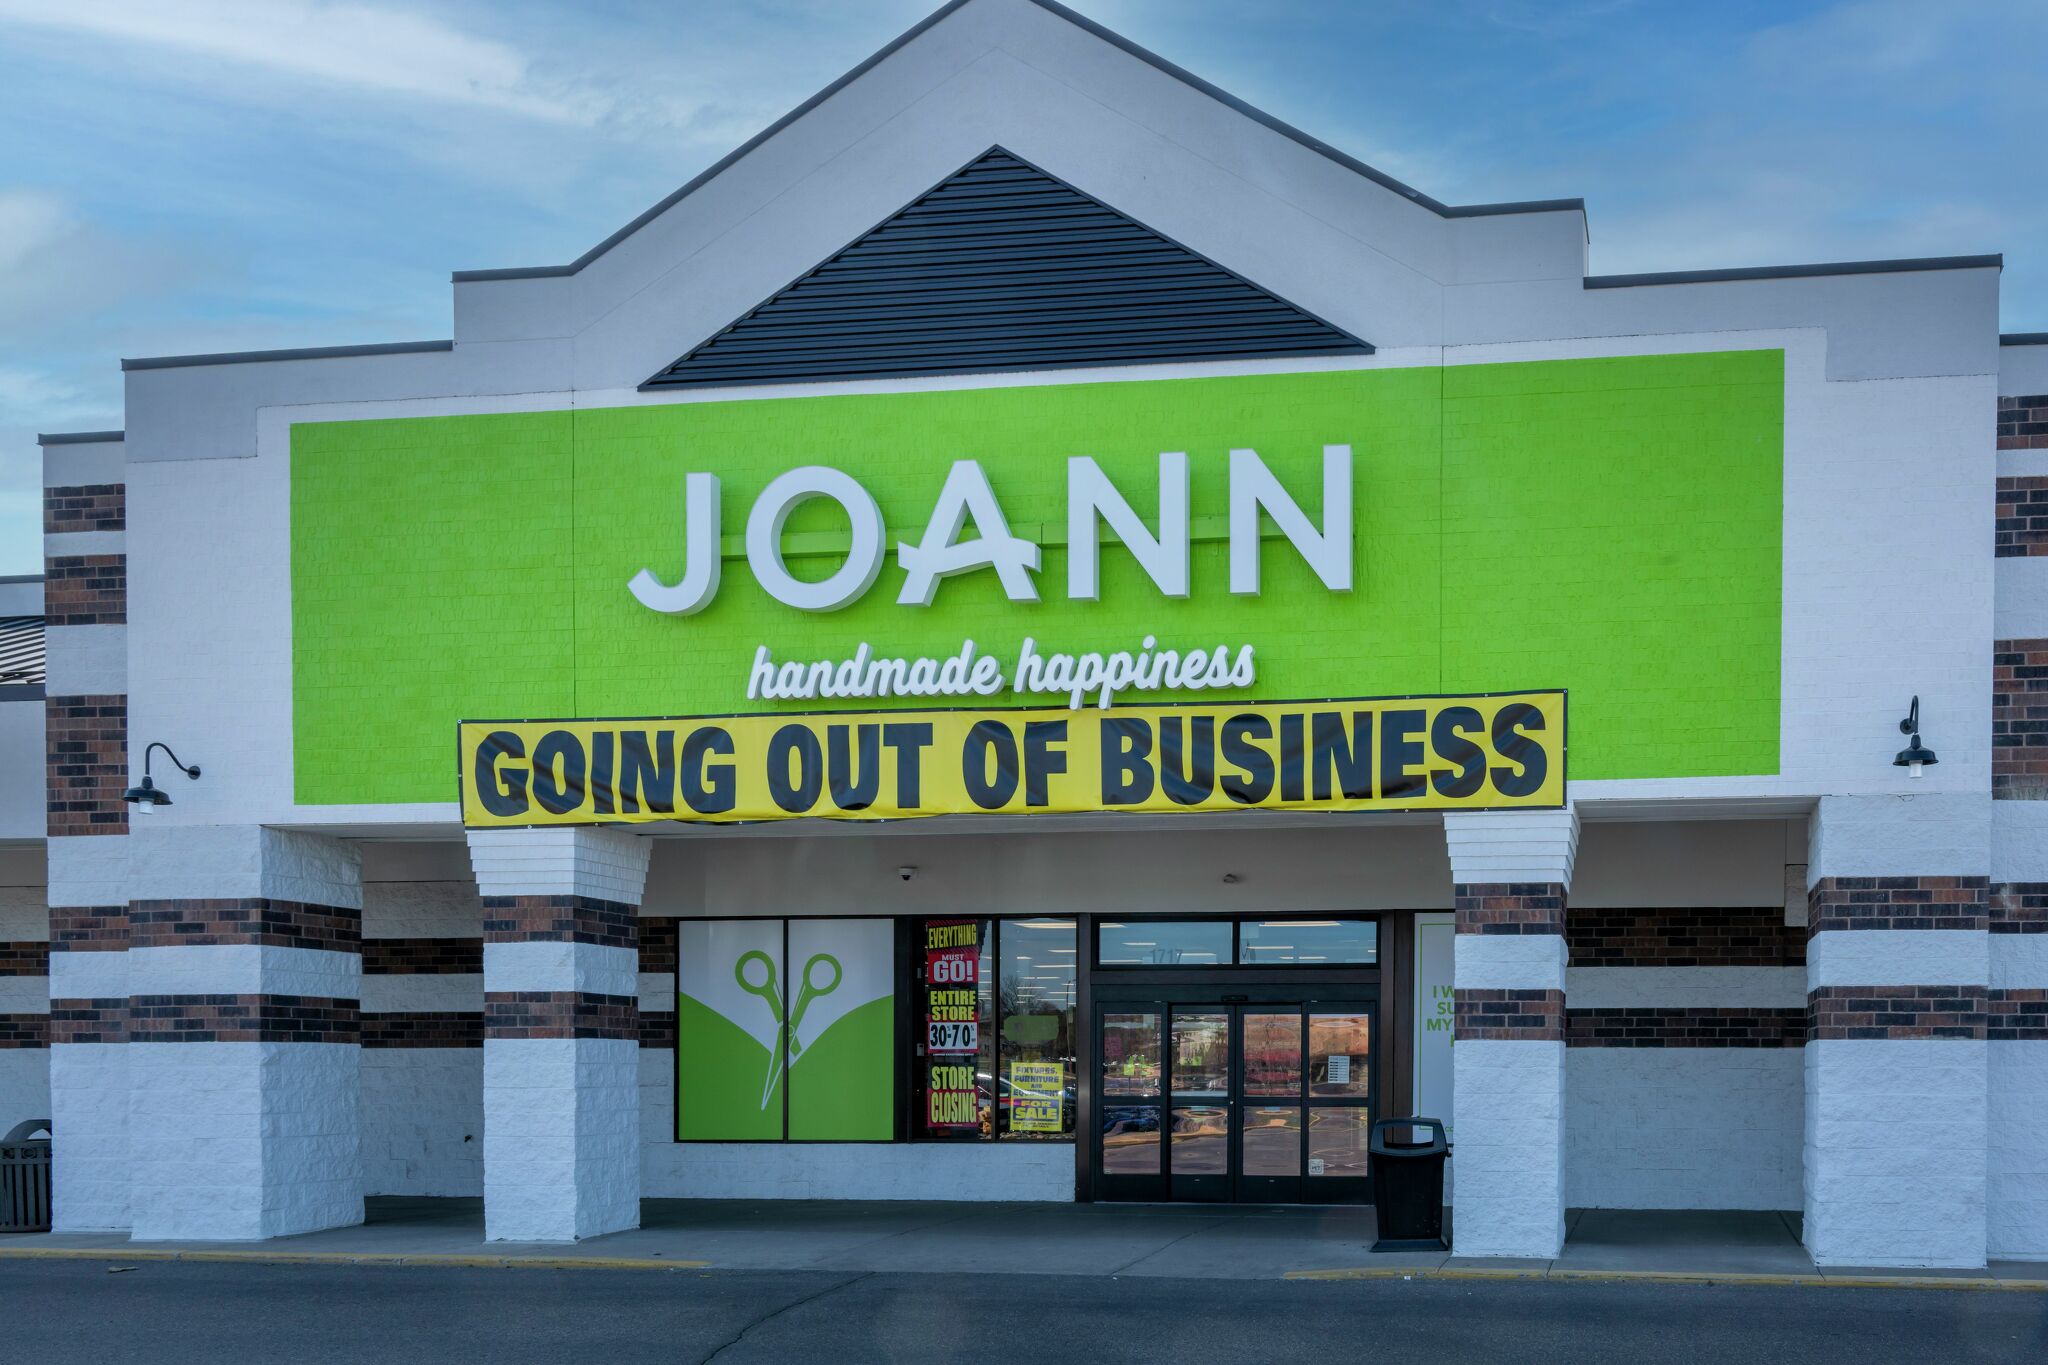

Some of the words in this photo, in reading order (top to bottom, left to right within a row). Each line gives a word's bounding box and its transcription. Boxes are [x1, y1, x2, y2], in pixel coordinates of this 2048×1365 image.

[628, 444, 1353, 616] JOANN
[746, 638, 1003, 701] handmade
[1014, 635, 1256, 711] happiness
[475, 726, 736, 818] GOING
[767, 722, 934, 814] OUT
[962, 719, 1068, 810] OF
[1101, 703, 1548, 806] BUSINESS
[928, 923, 977, 949] EVERYTHING
[941, 953, 965, 961] MUST
[933, 960, 973, 982] GO!
[930, 990, 976, 1006] ENTIRE
[931, 1005, 975, 1021] STORE
[1426, 1018, 1453, 1031] MY
[931, 1066, 975, 1090] STORE
[1014, 1075, 1059, 1083] FURNITURE
[1013, 1089, 1059, 1097] EQMENT
[931, 1091, 977, 1123] CLOSING
[1015, 1107, 1057, 1119] SALE
